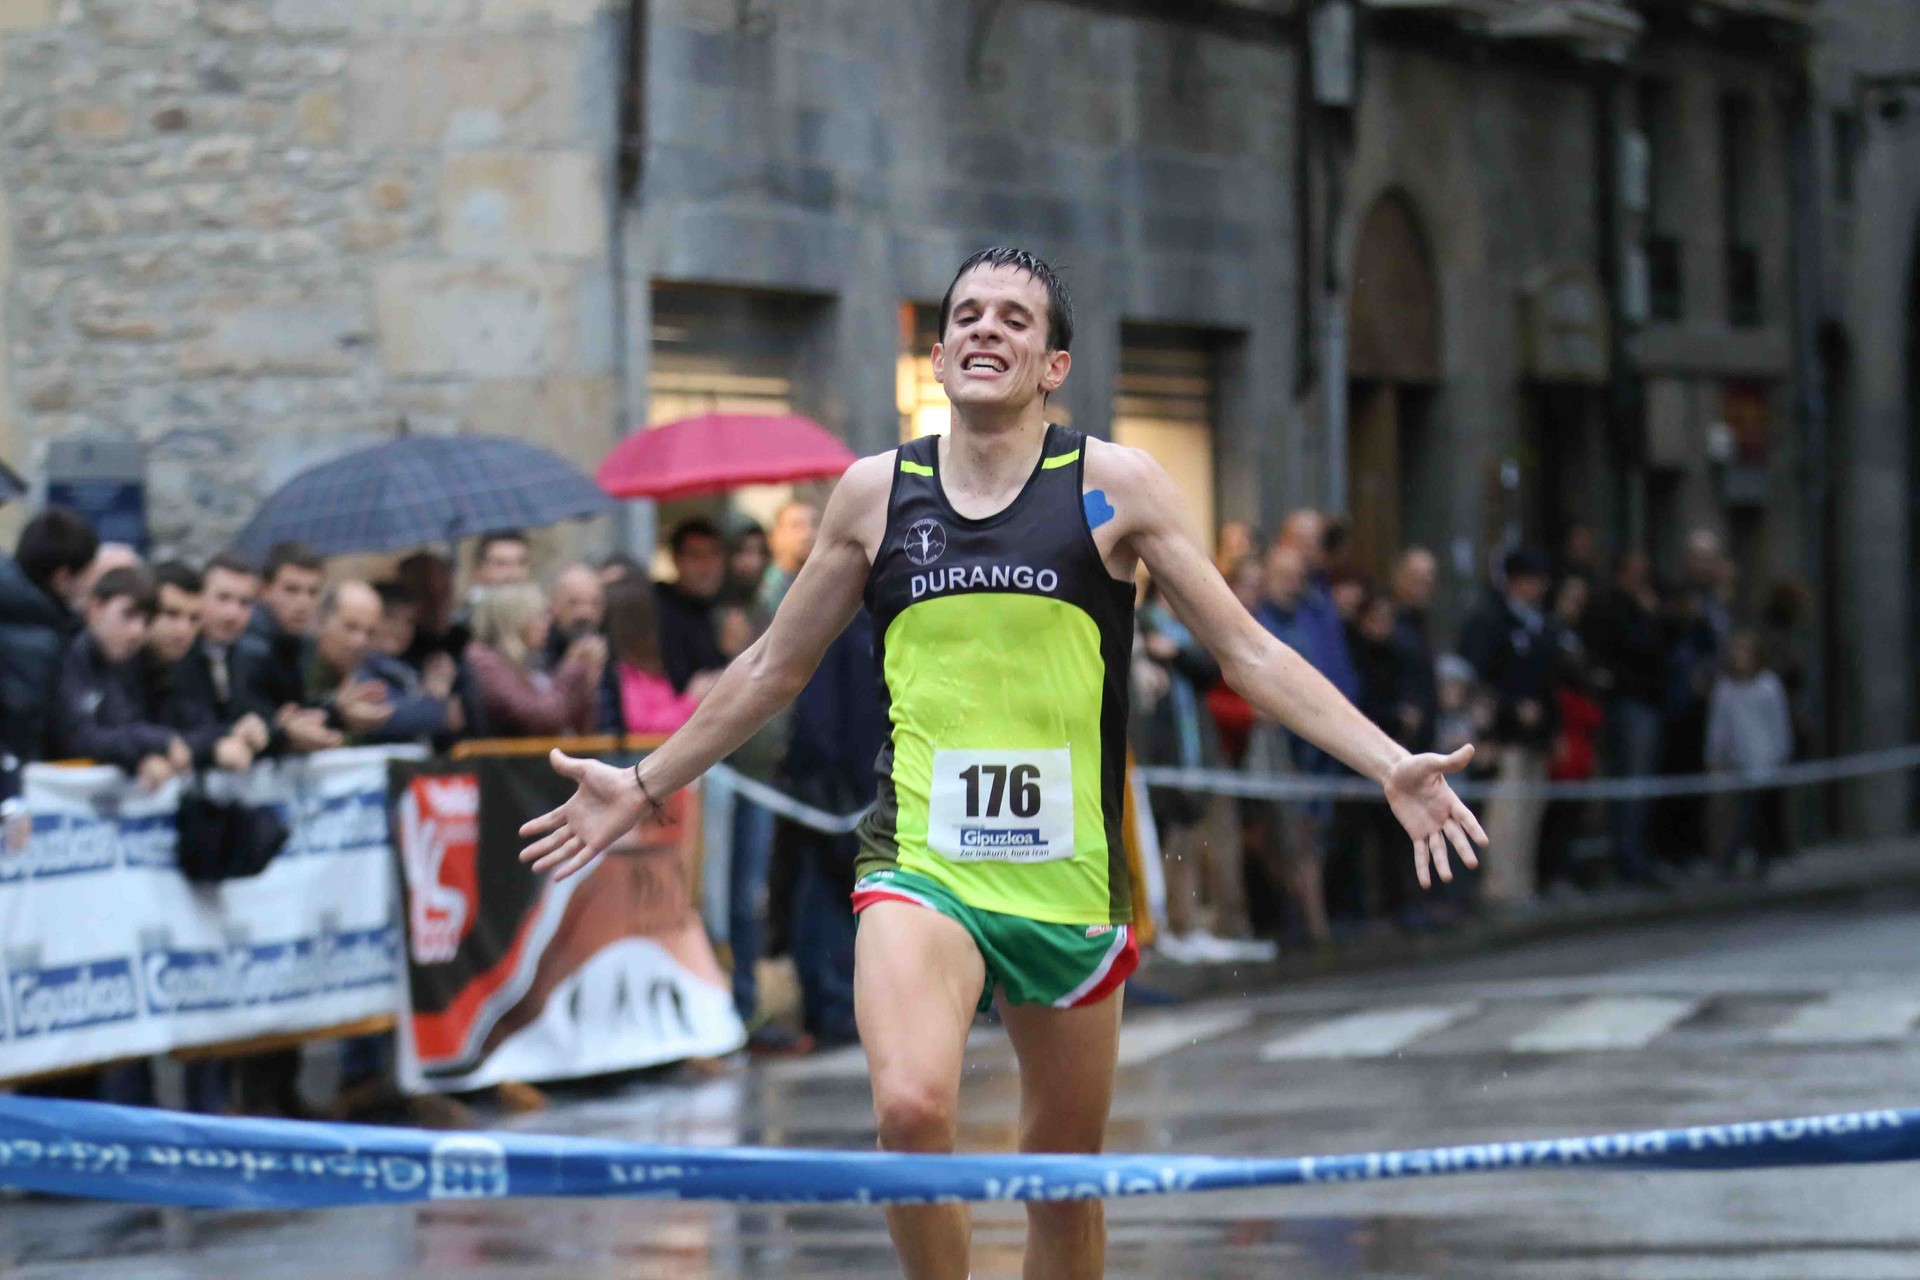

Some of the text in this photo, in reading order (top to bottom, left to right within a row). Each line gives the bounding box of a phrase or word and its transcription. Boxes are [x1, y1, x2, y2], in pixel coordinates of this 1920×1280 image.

[911, 565, 1058, 598] DURANGO
[959, 764, 1041, 818] 176
[964, 830, 1034, 847] Gipuzkoa
